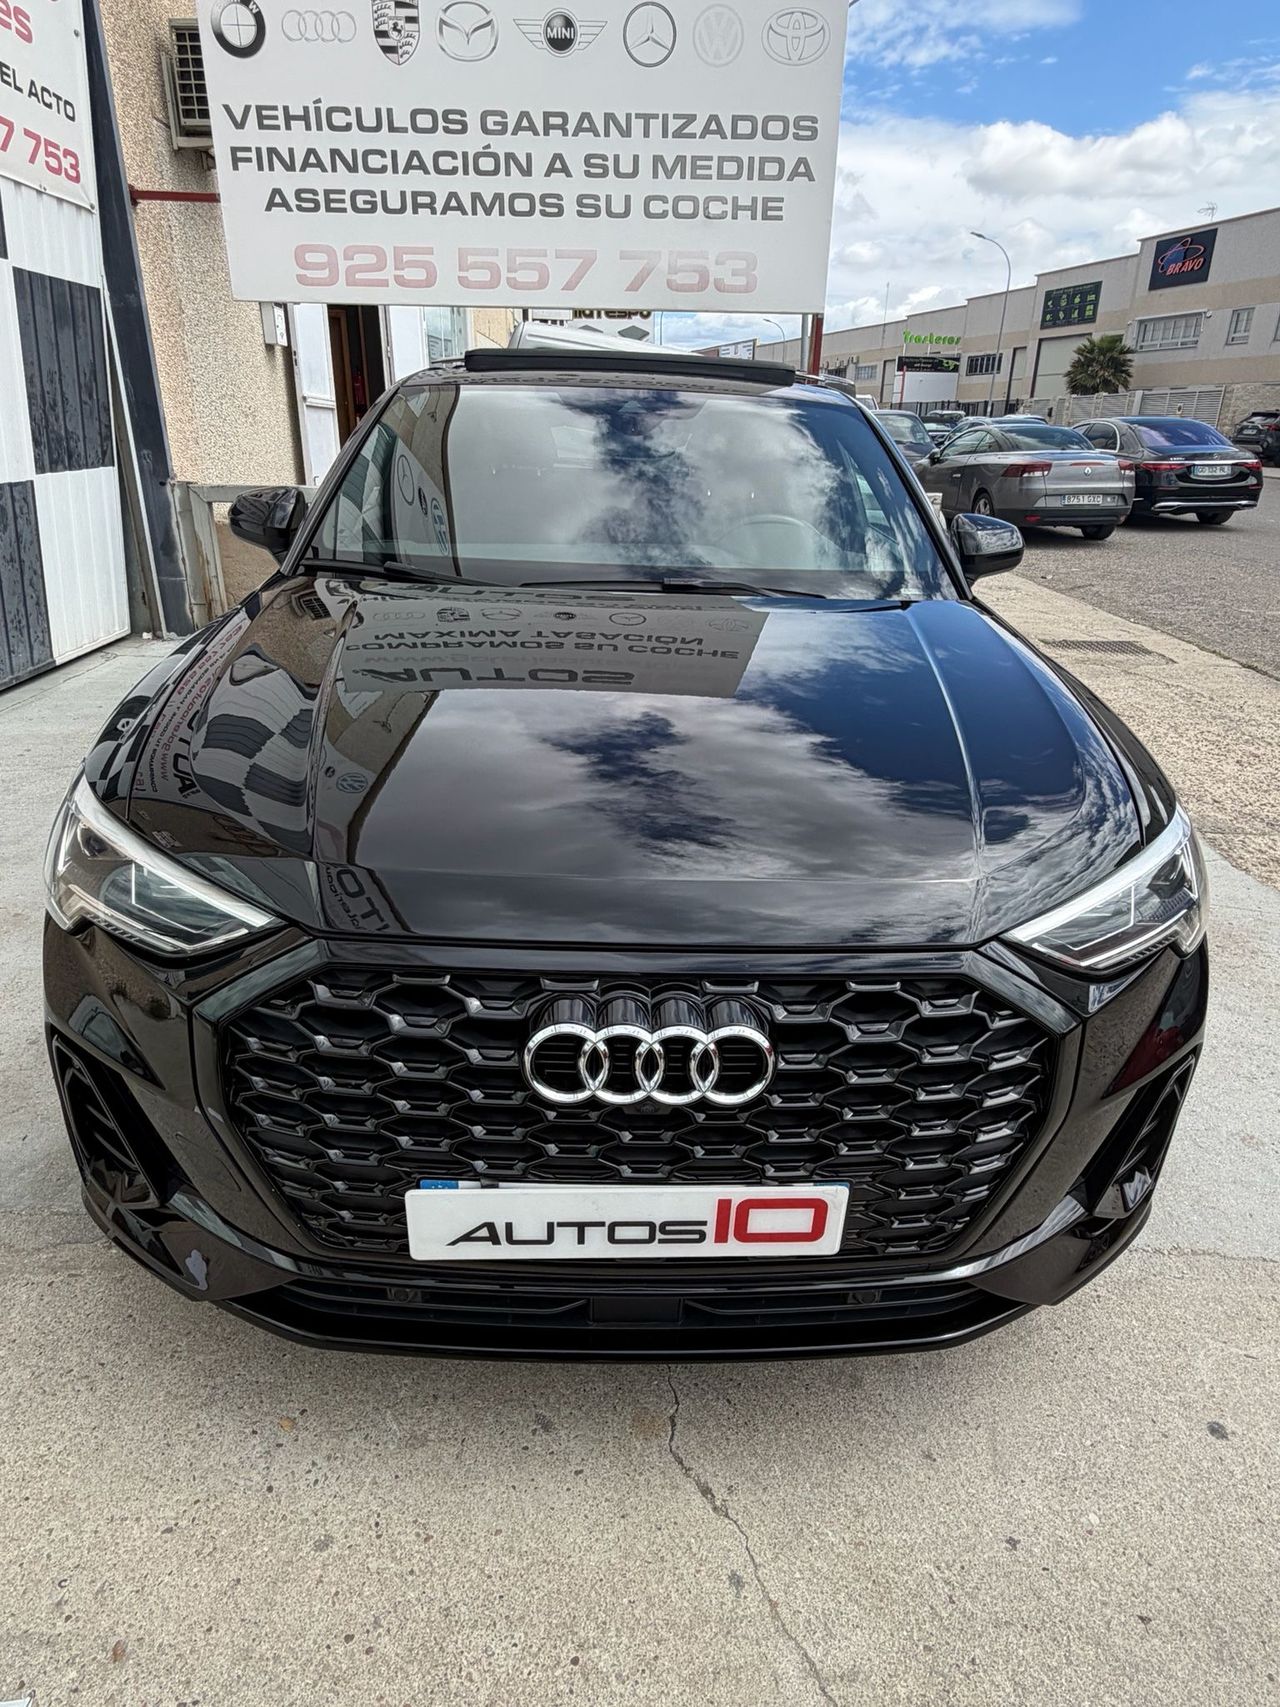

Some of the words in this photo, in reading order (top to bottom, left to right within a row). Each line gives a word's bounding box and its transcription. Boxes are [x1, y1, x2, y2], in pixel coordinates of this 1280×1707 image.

[547, 26, 574, 40] MINI
[28, 79, 76, 122] ACTO
[222, 98, 469, 135] VEHÍCULOS
[480, 109, 819, 141] GARANTIZADOS
[23, 127, 81, 184] 753
[230, 144, 533, 177] FINANCIACIÓN
[544, 152, 573, 178] A
[584, 154, 640, 180] SU
[652, 155, 816, 182] MEDIDA
[264, 187, 564, 217] ASEGURAMOS
[576, 194, 631, 219] SU
[643, 195, 785, 221] COCHE
[294, 243, 438, 290] 925
[457, 247, 597, 292] 557
[619, 249, 758, 294] 753
[1166, 257, 1205, 275] BRAVO
[902, 328, 962, 346] Trasteros
